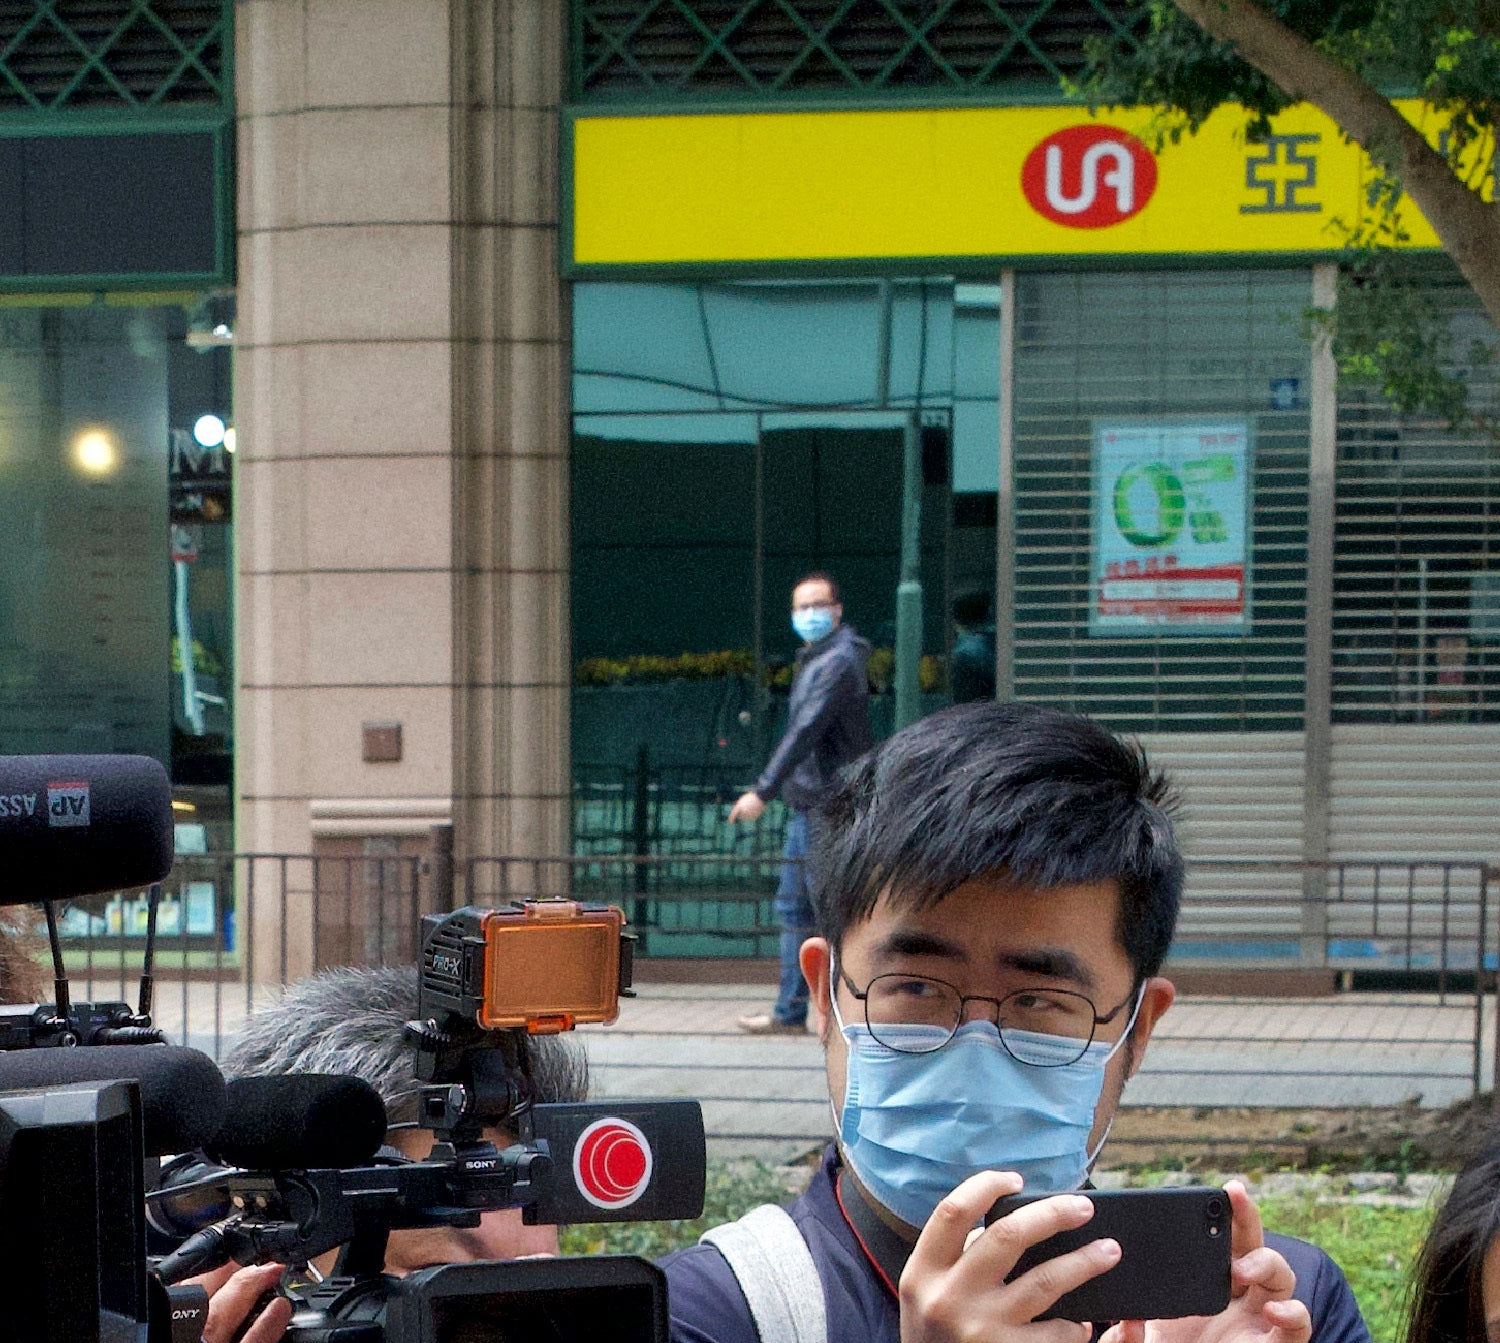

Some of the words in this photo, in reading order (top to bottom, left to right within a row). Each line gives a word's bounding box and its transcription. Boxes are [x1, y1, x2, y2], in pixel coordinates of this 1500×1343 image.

[51, 795, 86, 817] AP
[465, 1160, 497, 1170] SONY
[172, 1308, 200, 1321] ONY
